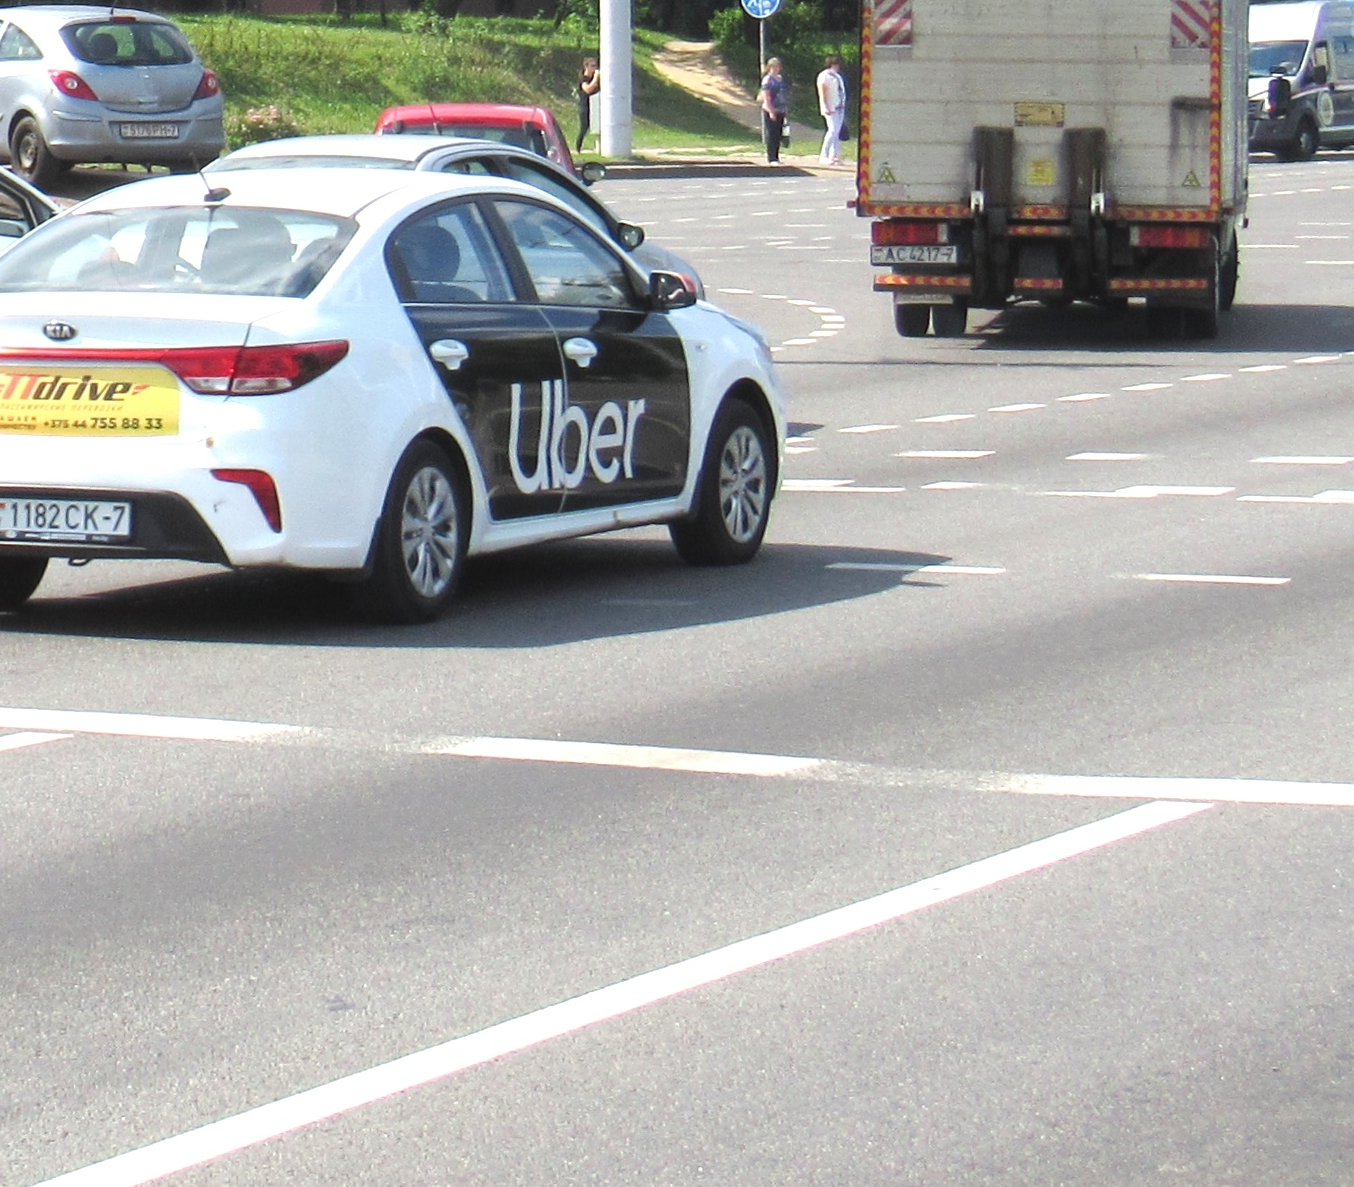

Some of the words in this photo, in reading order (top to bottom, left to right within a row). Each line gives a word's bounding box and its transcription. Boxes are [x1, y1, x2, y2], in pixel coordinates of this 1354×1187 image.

[90, 417, 117, 429] 755
[121, 418, 140, 429] 88
[145, 418, 163, 429] 33
[509, 379, 646, 495] Uber
